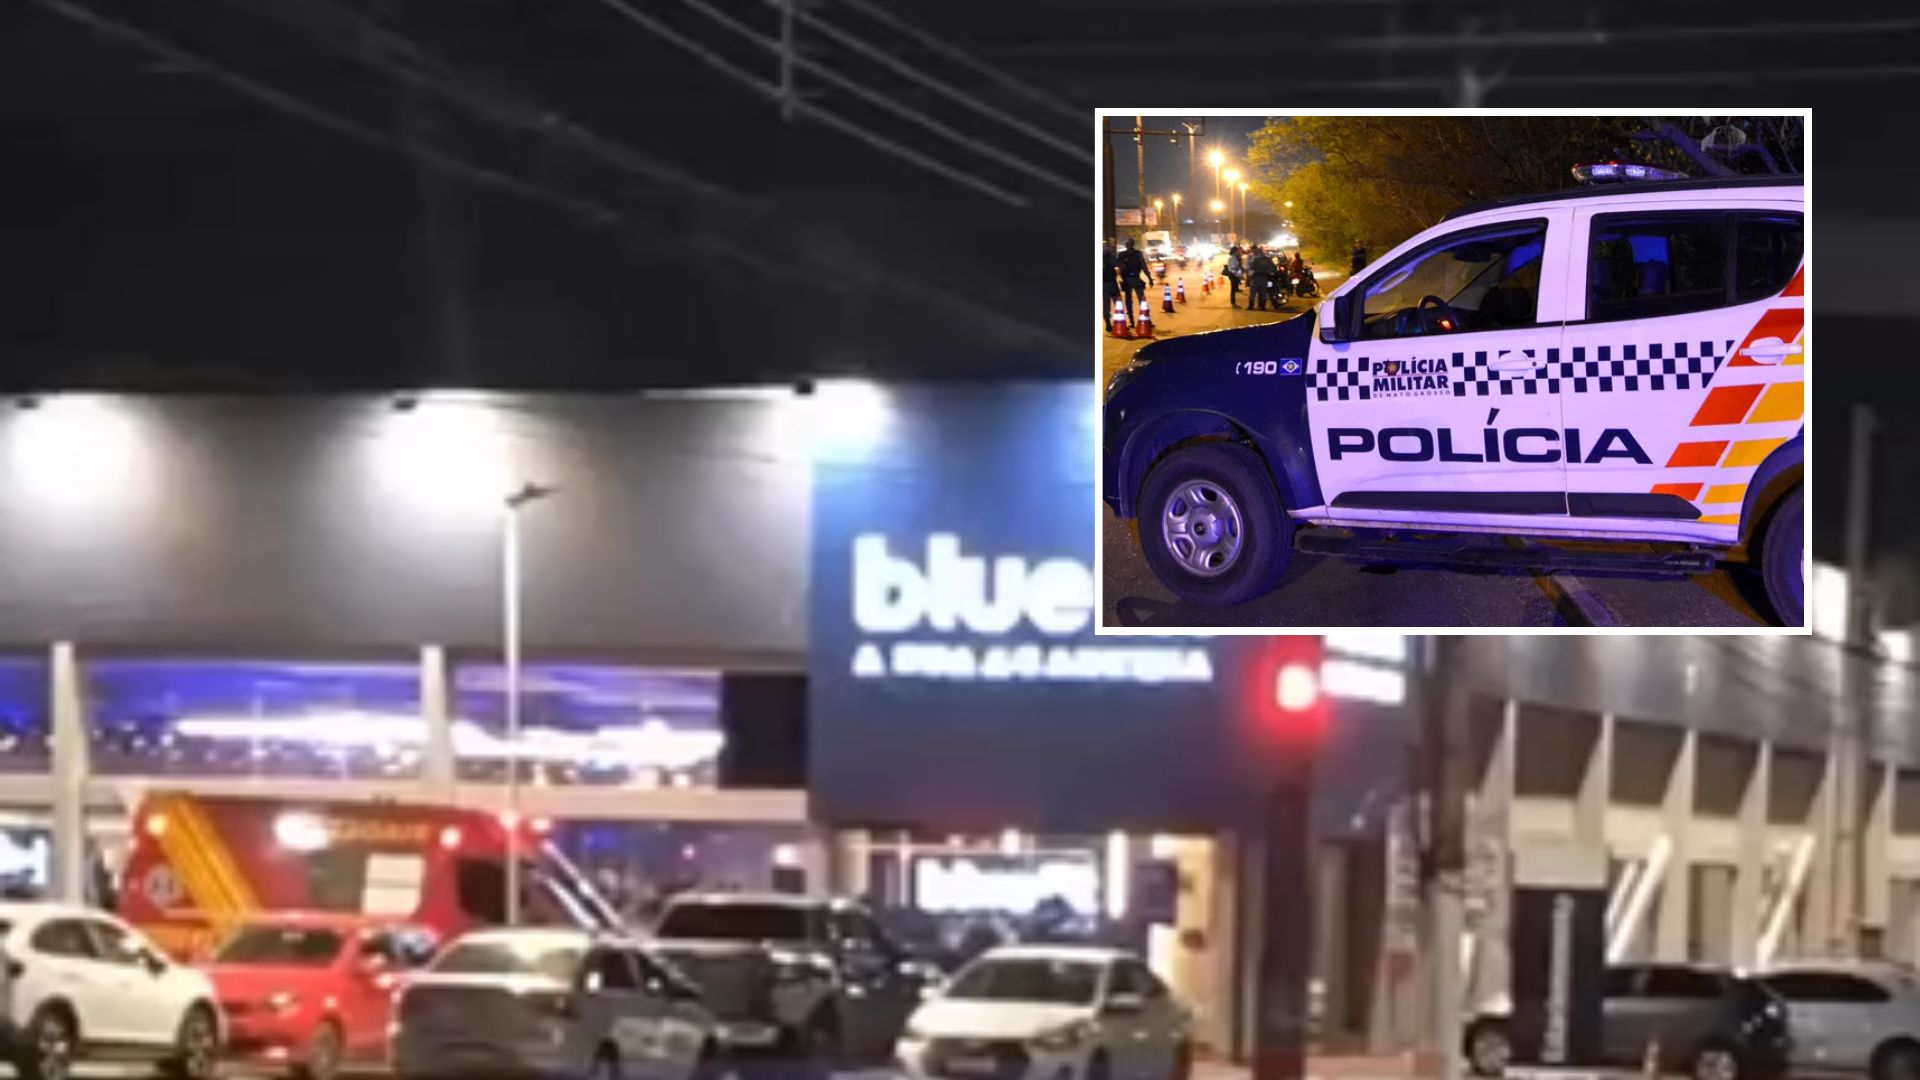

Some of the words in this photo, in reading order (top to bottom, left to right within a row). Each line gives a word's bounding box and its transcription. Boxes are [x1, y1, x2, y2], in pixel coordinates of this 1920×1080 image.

[1243, 361, 1277, 375] 190
[1373, 375, 1449, 392] MILITAR
[1327, 407, 1654, 464] POLÍCIA
